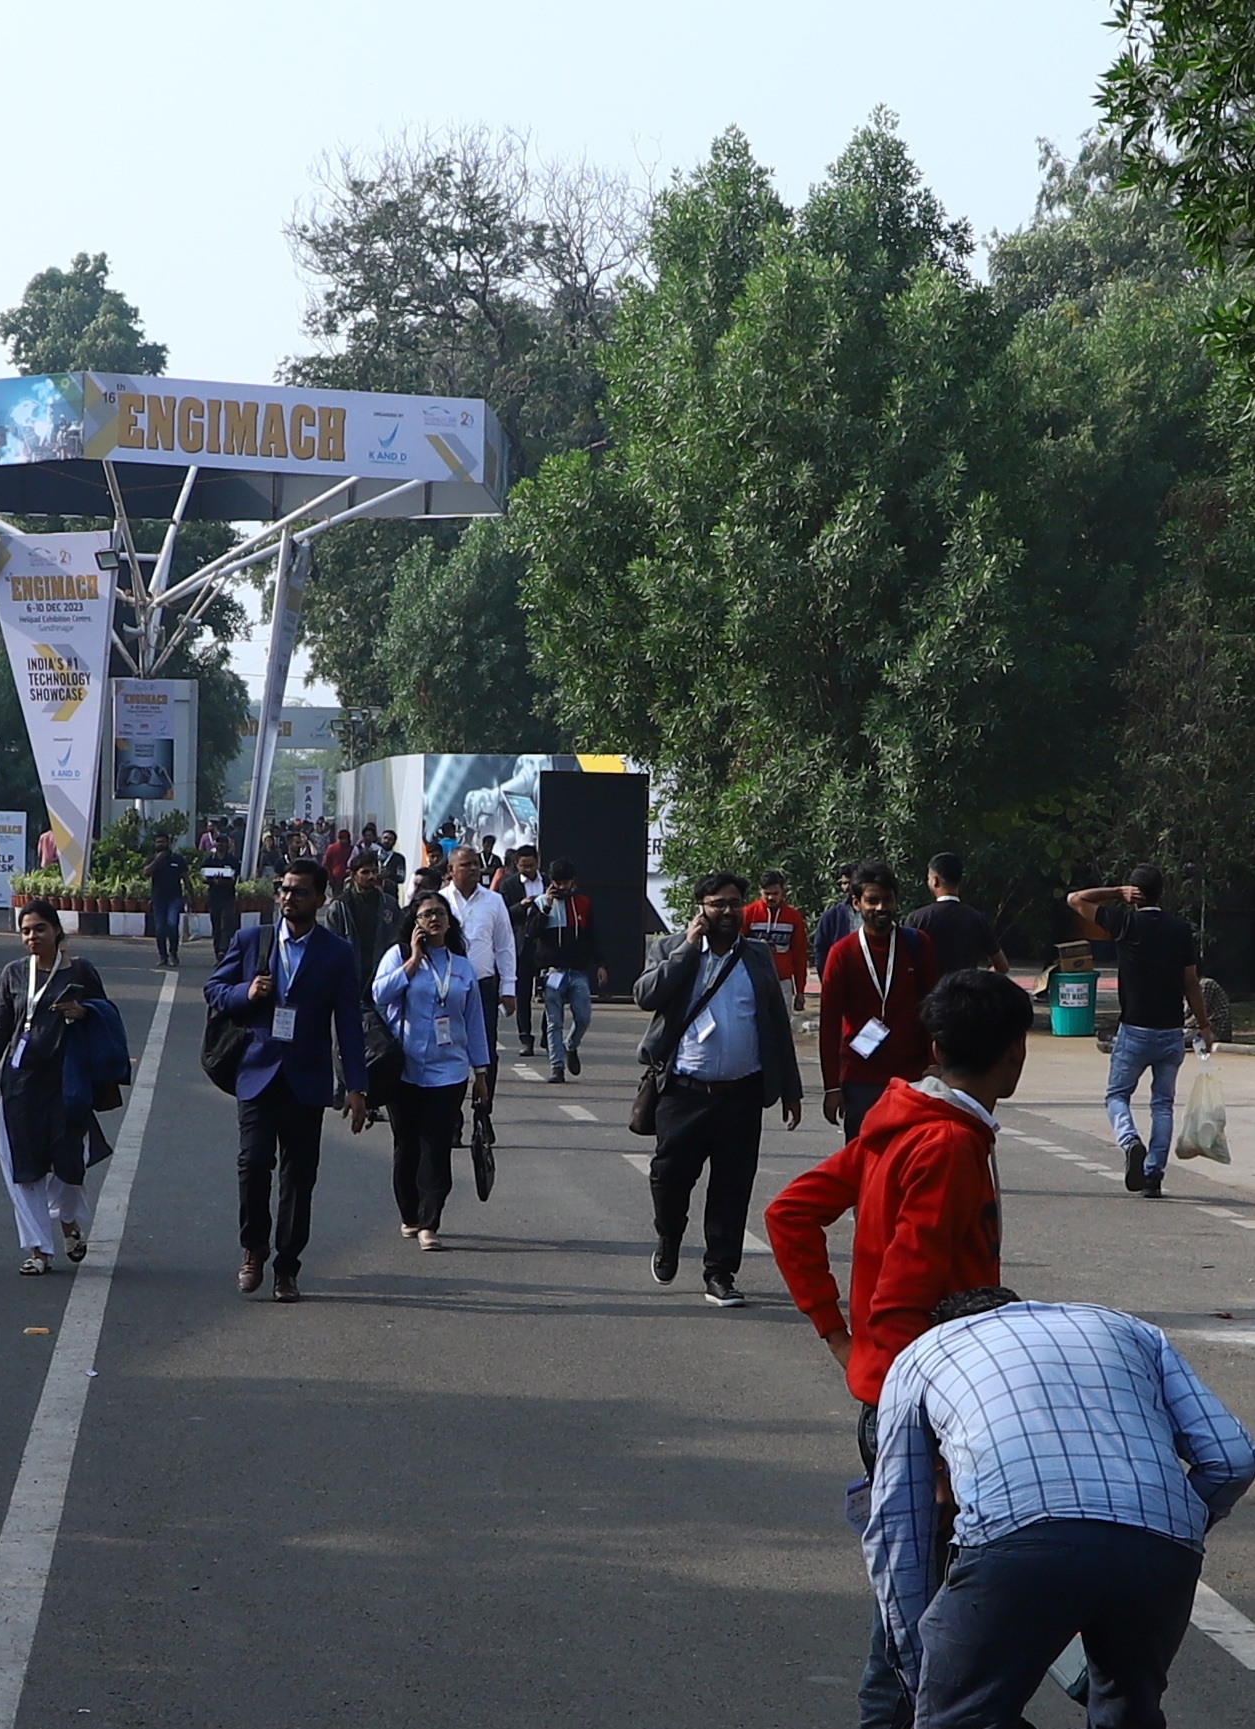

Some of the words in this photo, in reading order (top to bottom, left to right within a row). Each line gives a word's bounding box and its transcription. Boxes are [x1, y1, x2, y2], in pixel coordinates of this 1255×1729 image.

[118, 392, 346, 461] ENGIMACH
[368, 451, 375, 460] K
[377, 452, 397, 461] AND
[400, 453, 407, 462] D
[10, 574, 99, 601] ENGIMACH
[46, 603, 62, 612] DEC
[64, 602, 83, 612] 2023
[27, 657, 64, 671] INDIA'S
[28, 672, 91, 686] TECHNOLOGY
[30, 688, 84, 701] SHOWCASE
